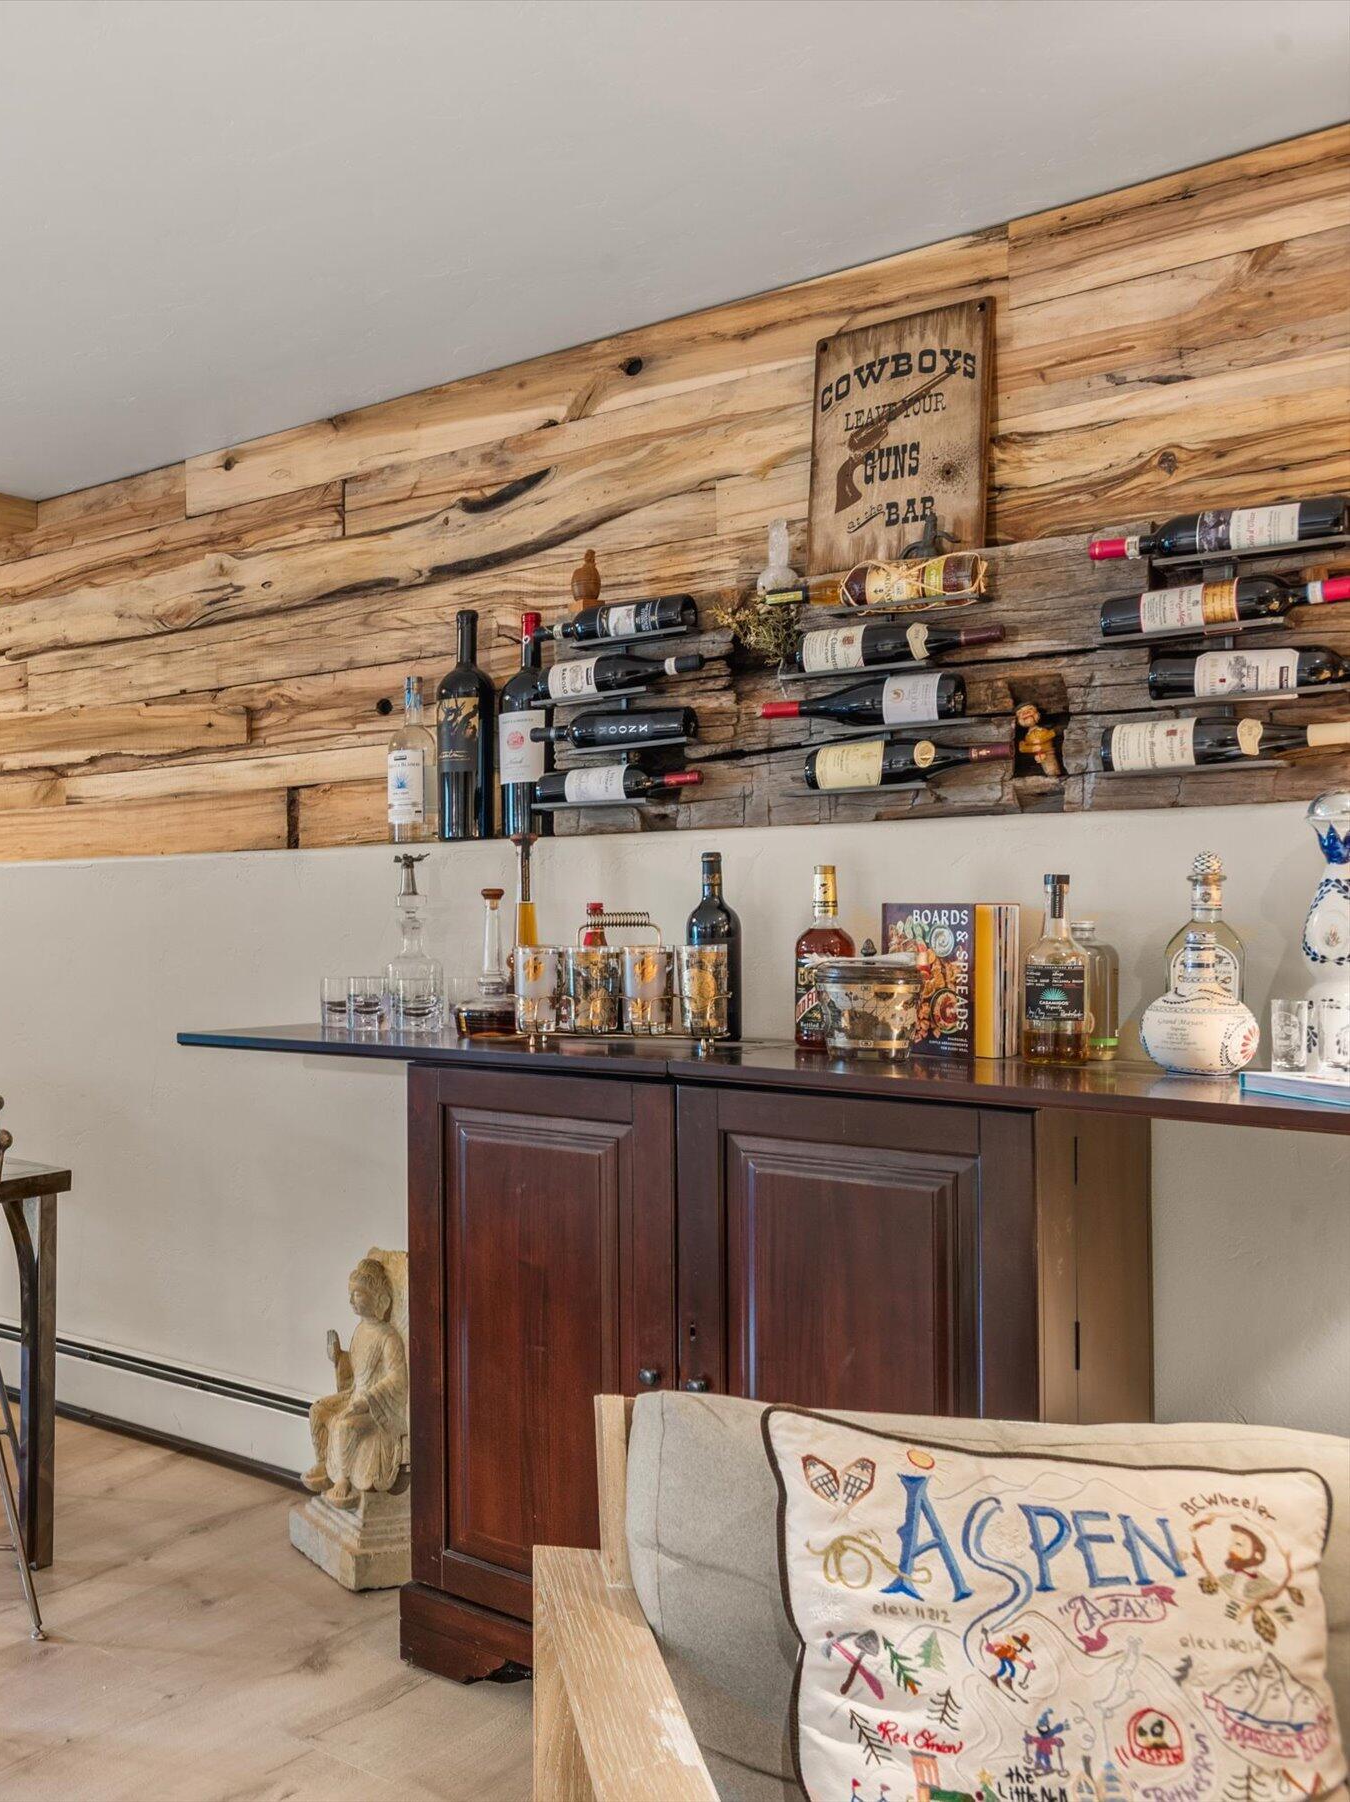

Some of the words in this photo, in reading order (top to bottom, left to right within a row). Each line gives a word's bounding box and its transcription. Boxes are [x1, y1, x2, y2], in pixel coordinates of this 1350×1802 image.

[821, 349, 976, 412] COWBOYS
[844, 401, 898, 431] LEAVE
[863, 441, 920, 484] GUNS
[885, 495, 935, 527] BAR
[912, 909, 969, 926] BOARDS
[955, 930, 969, 943] &
[955, 949, 969, 1032] SPREADS
[880, 1473, 1187, 1640] ASPEN
[872, 1602, 909, 1616] elev
[876, 1719, 909, 1746] Red
[1005, 1765, 1035, 1785] the
